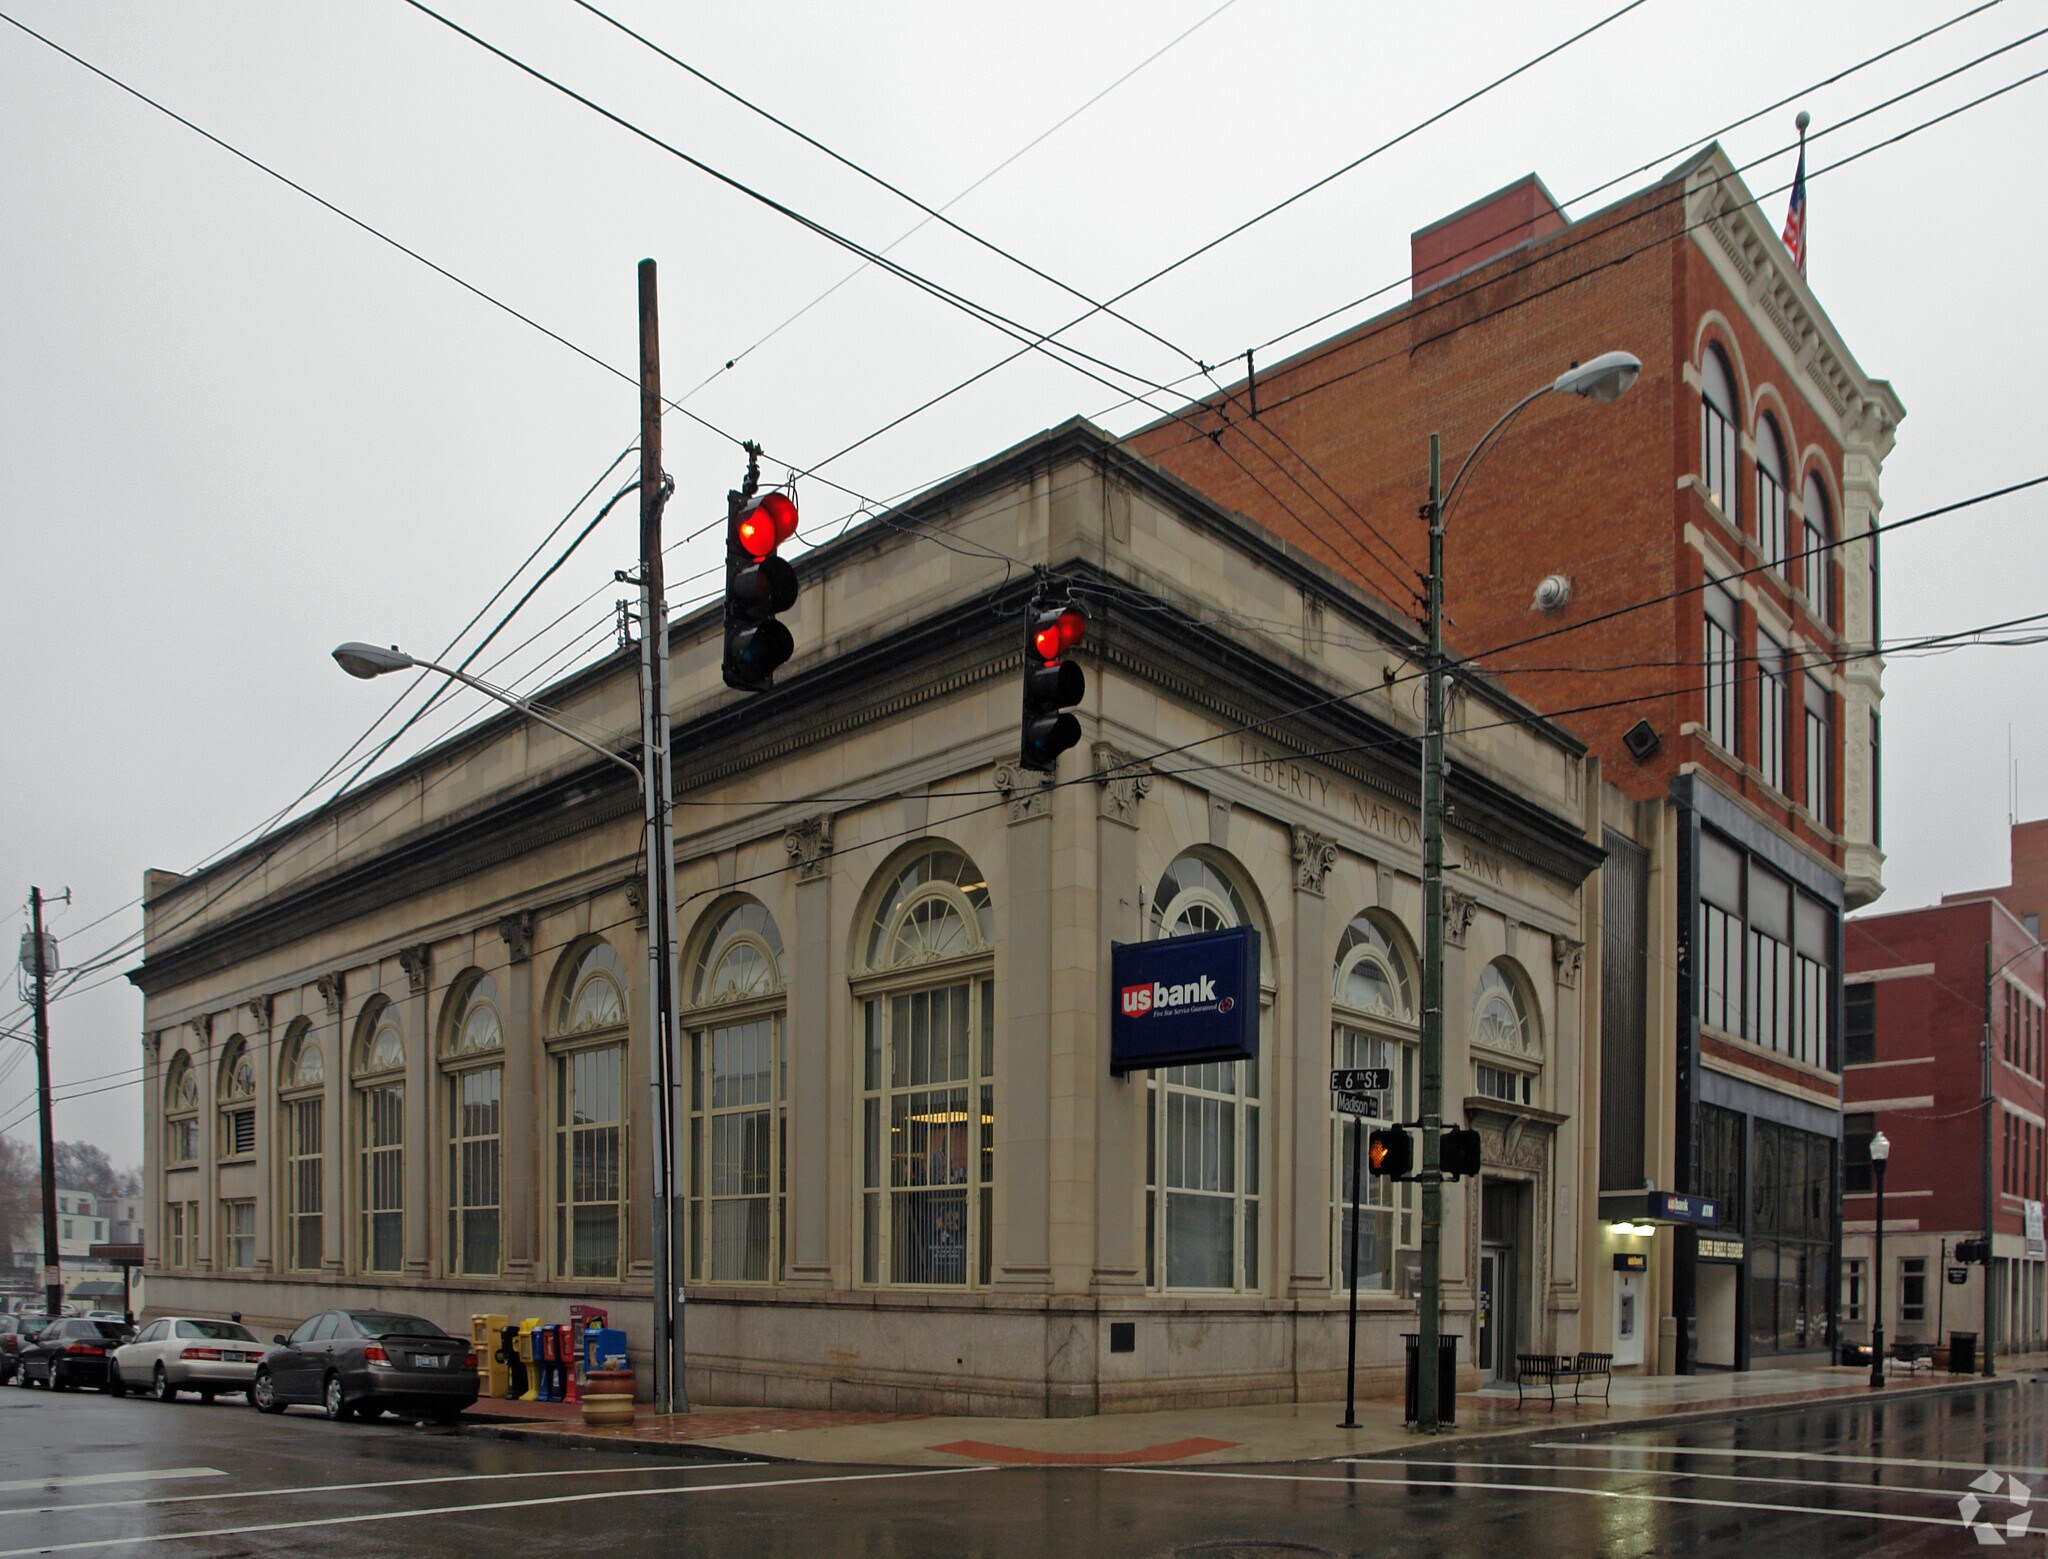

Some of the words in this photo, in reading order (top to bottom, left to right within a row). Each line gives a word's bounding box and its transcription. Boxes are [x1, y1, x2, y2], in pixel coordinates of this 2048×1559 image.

[1239, 741, 1330, 806] LIBERTY
[1463, 845, 1504, 887] BANK
[1153, 1010, 1164, 1018] Five
[1164, 1009, 1173, 1017] Star
[1190, 1003, 1218, 1013] Guaranteed
[1331, 1072, 1342, 1089] E.
[1364, 1070, 1381, 1088] St.
[1338, 1092, 1368, 1114] Madison
